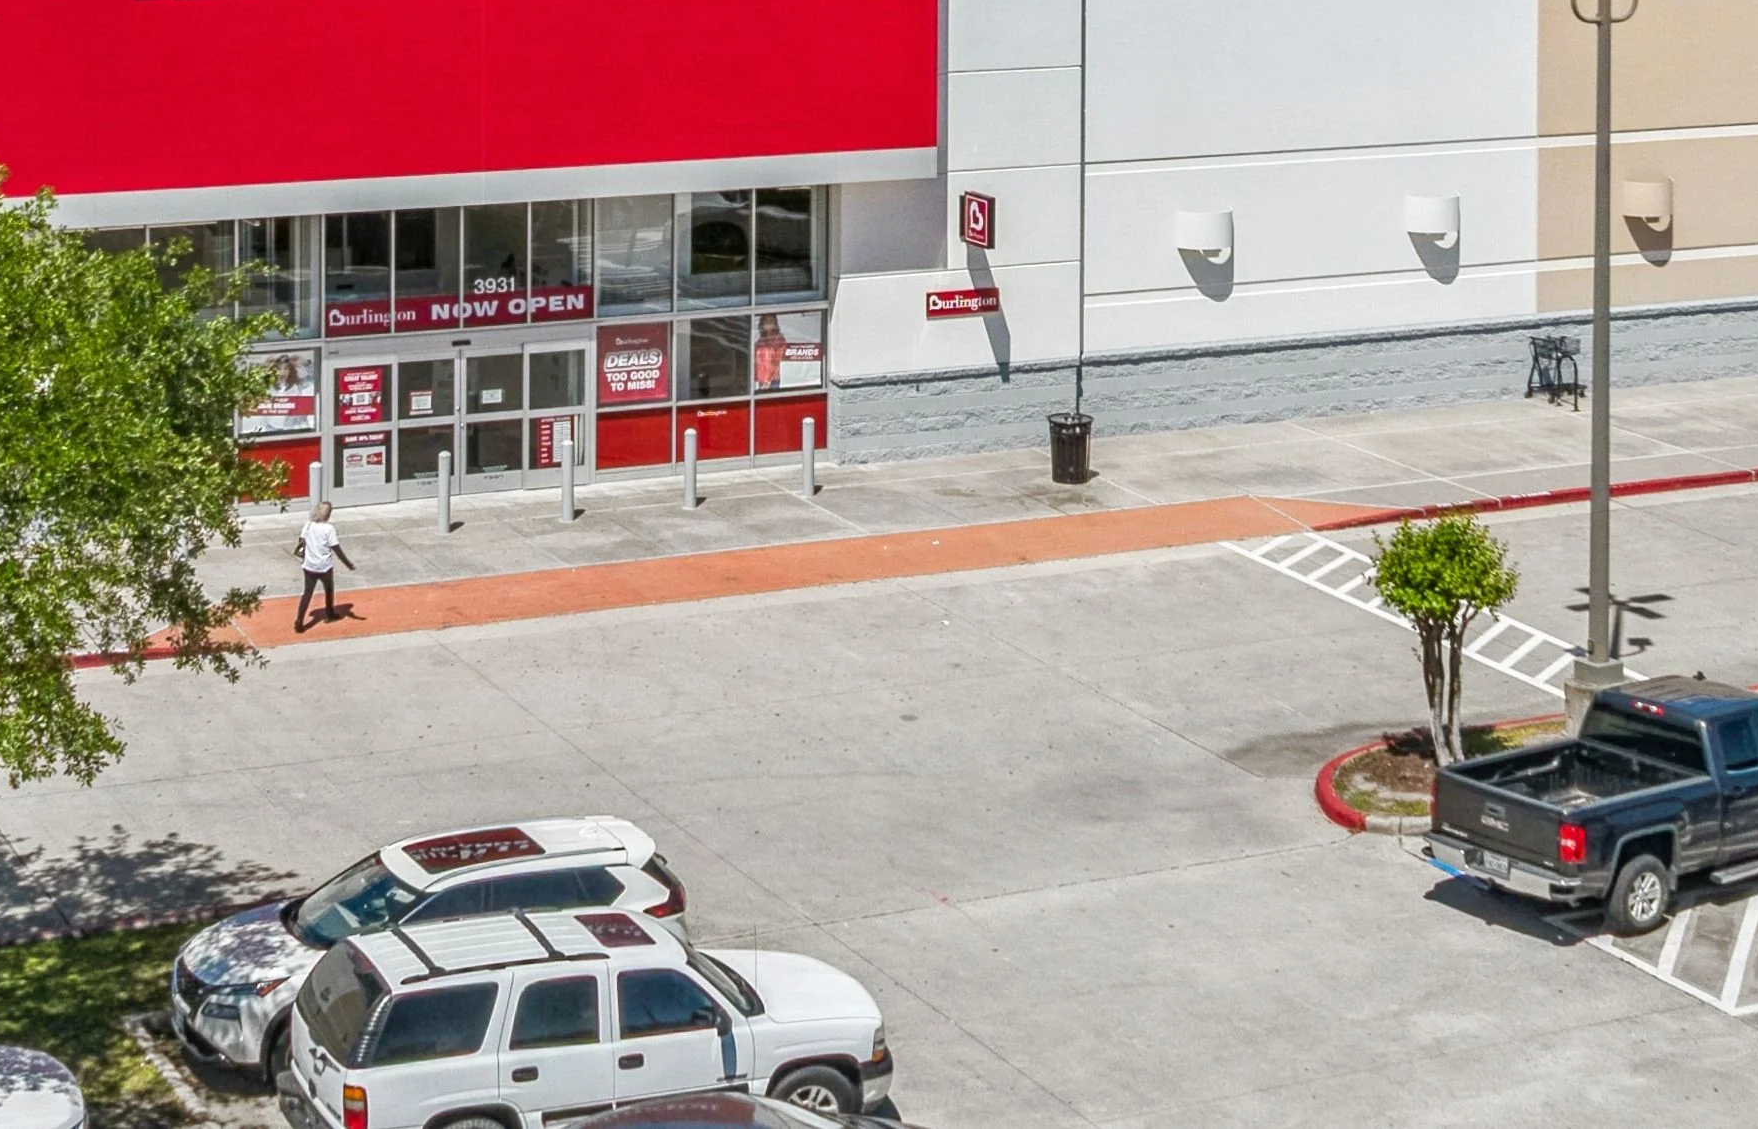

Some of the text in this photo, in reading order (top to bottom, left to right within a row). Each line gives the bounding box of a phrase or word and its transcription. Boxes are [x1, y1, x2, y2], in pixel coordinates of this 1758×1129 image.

[474, 277, 515, 294] 3931
[928, 295, 996, 310] Burlington
[329, 294, 584, 327] Burlington NOW OPEN
[606, 350, 660, 368] DEALS
[785, 348, 820, 357] BRANDS
[606, 369, 660, 382] TOO GOOD
[610, 379, 656, 391] TO MISS!
